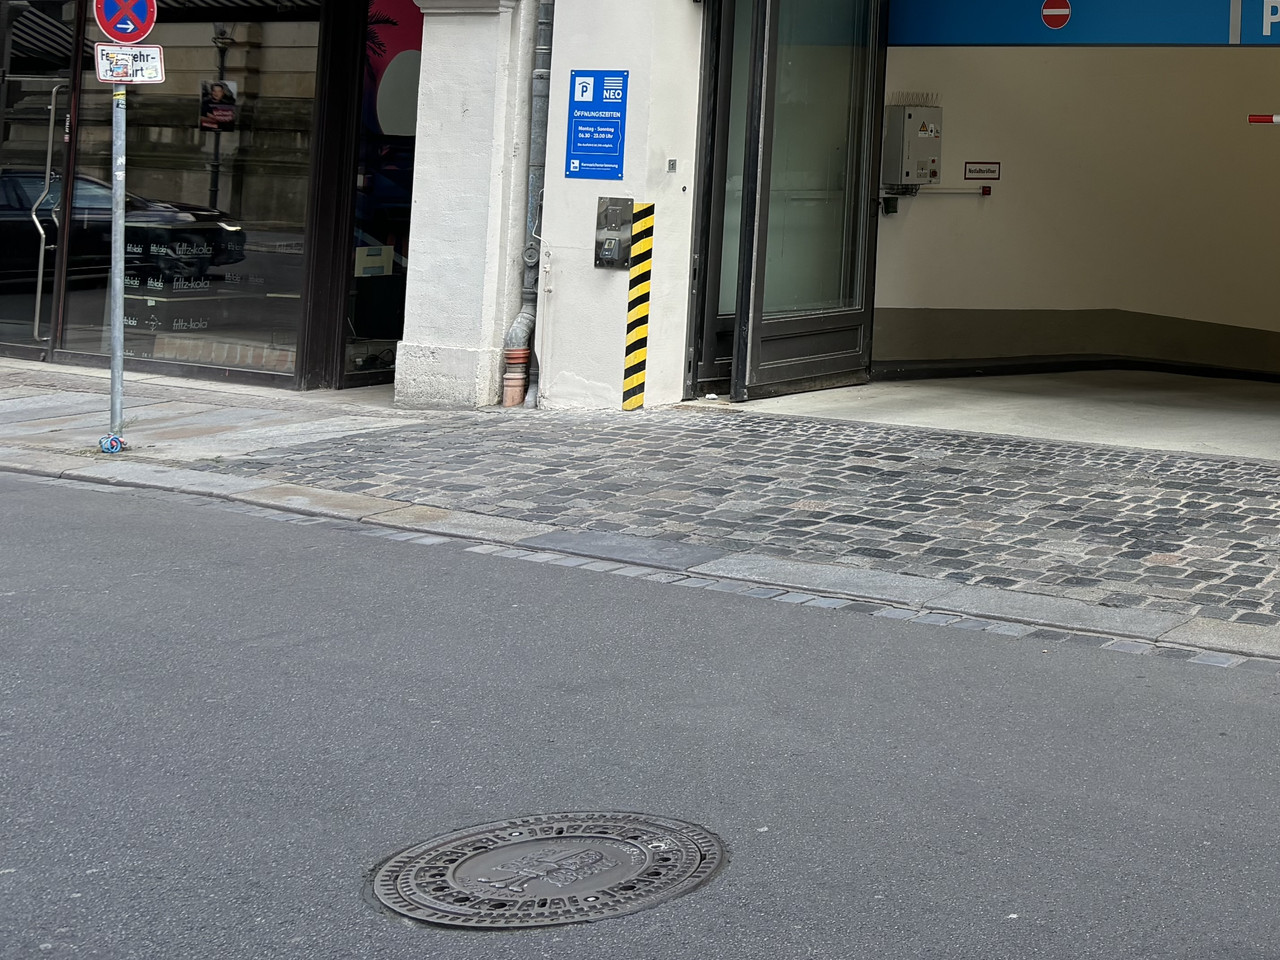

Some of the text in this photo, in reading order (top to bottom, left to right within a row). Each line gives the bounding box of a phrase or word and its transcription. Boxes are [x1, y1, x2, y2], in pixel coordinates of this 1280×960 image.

[581, 85, 588, 97] P
[603, 89, 622, 99] NEO
[573, 109, 621, 118] ÖFFNUNGSZEITEN
[176, 242, 212, 255] fritz-kola
[173, 276, 210, 289] fritz-kola
[172, 317, 208, 330] fritz-kola
